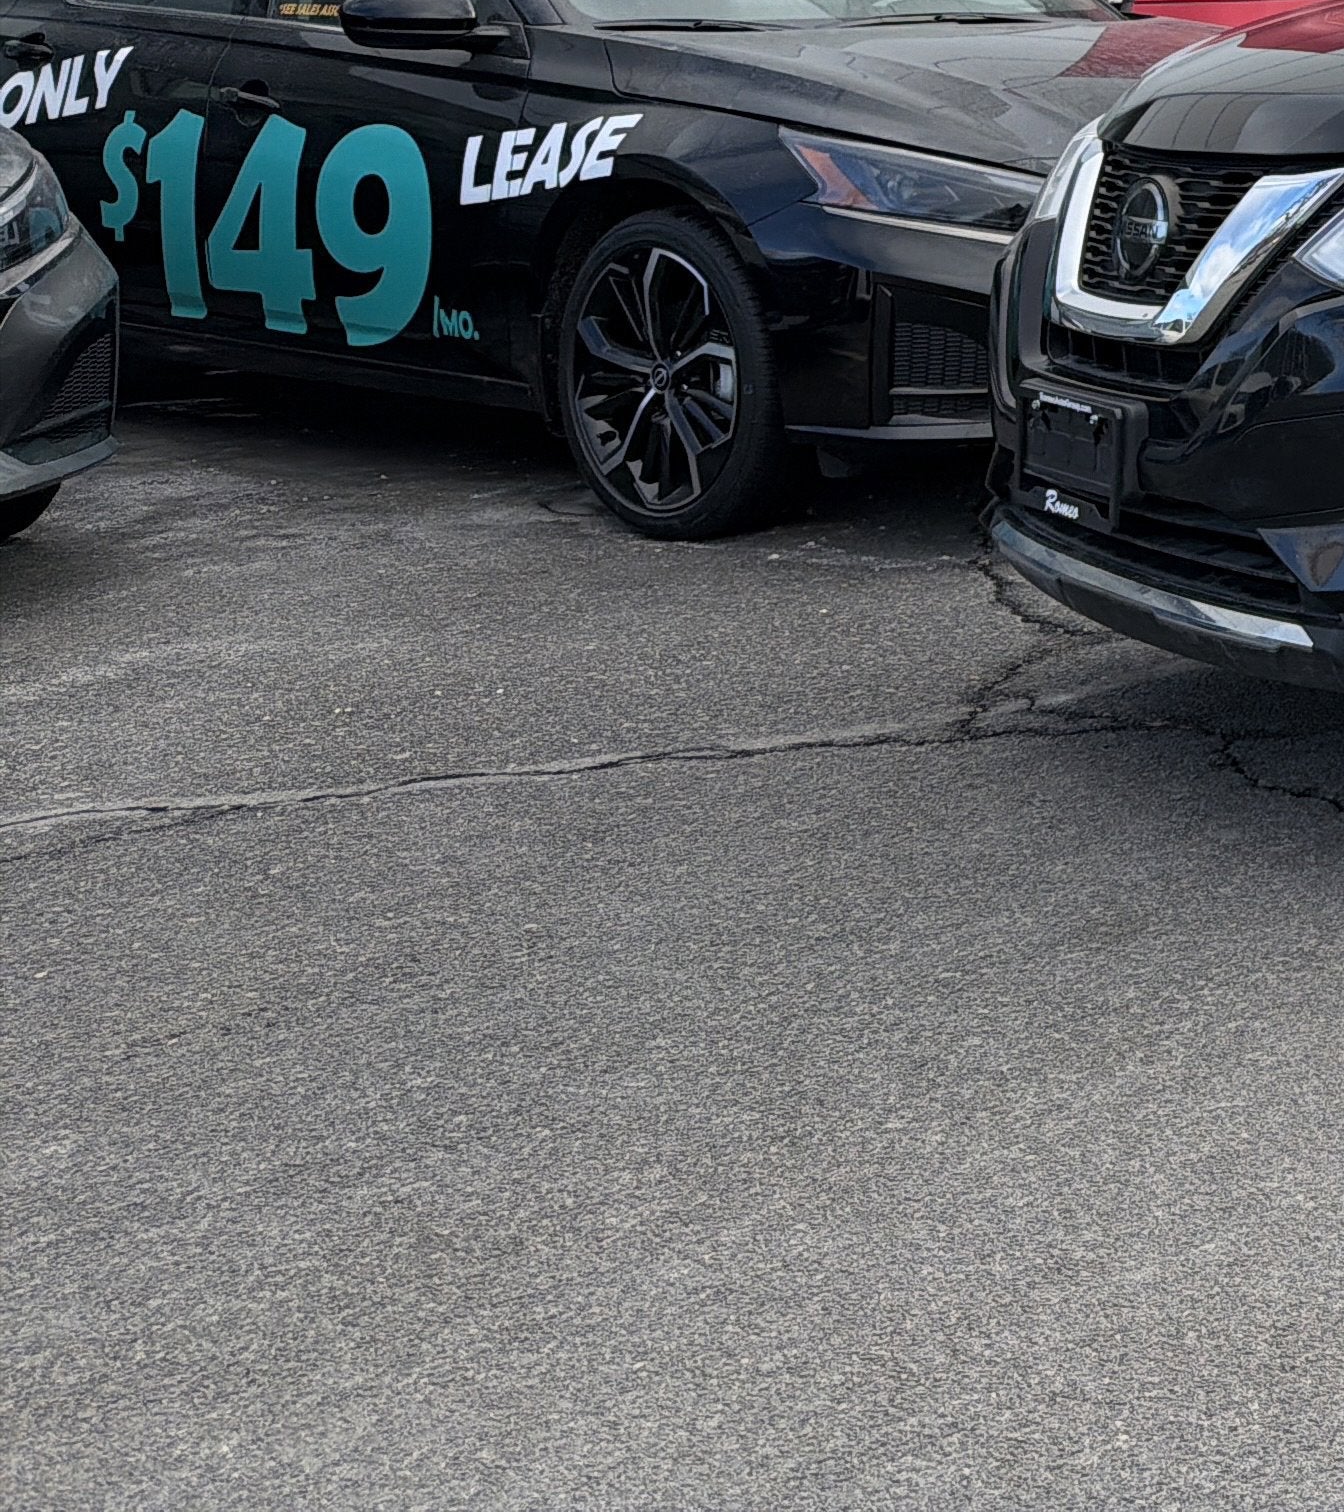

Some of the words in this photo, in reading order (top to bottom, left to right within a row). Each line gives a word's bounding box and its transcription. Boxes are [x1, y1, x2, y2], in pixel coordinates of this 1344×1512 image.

[0, 45, 135, 131] ONLY
[459, 112, 645, 207] LEASE
[99, 108, 433, 347] $149
[1044, 488, 1080, 520] Romeo
